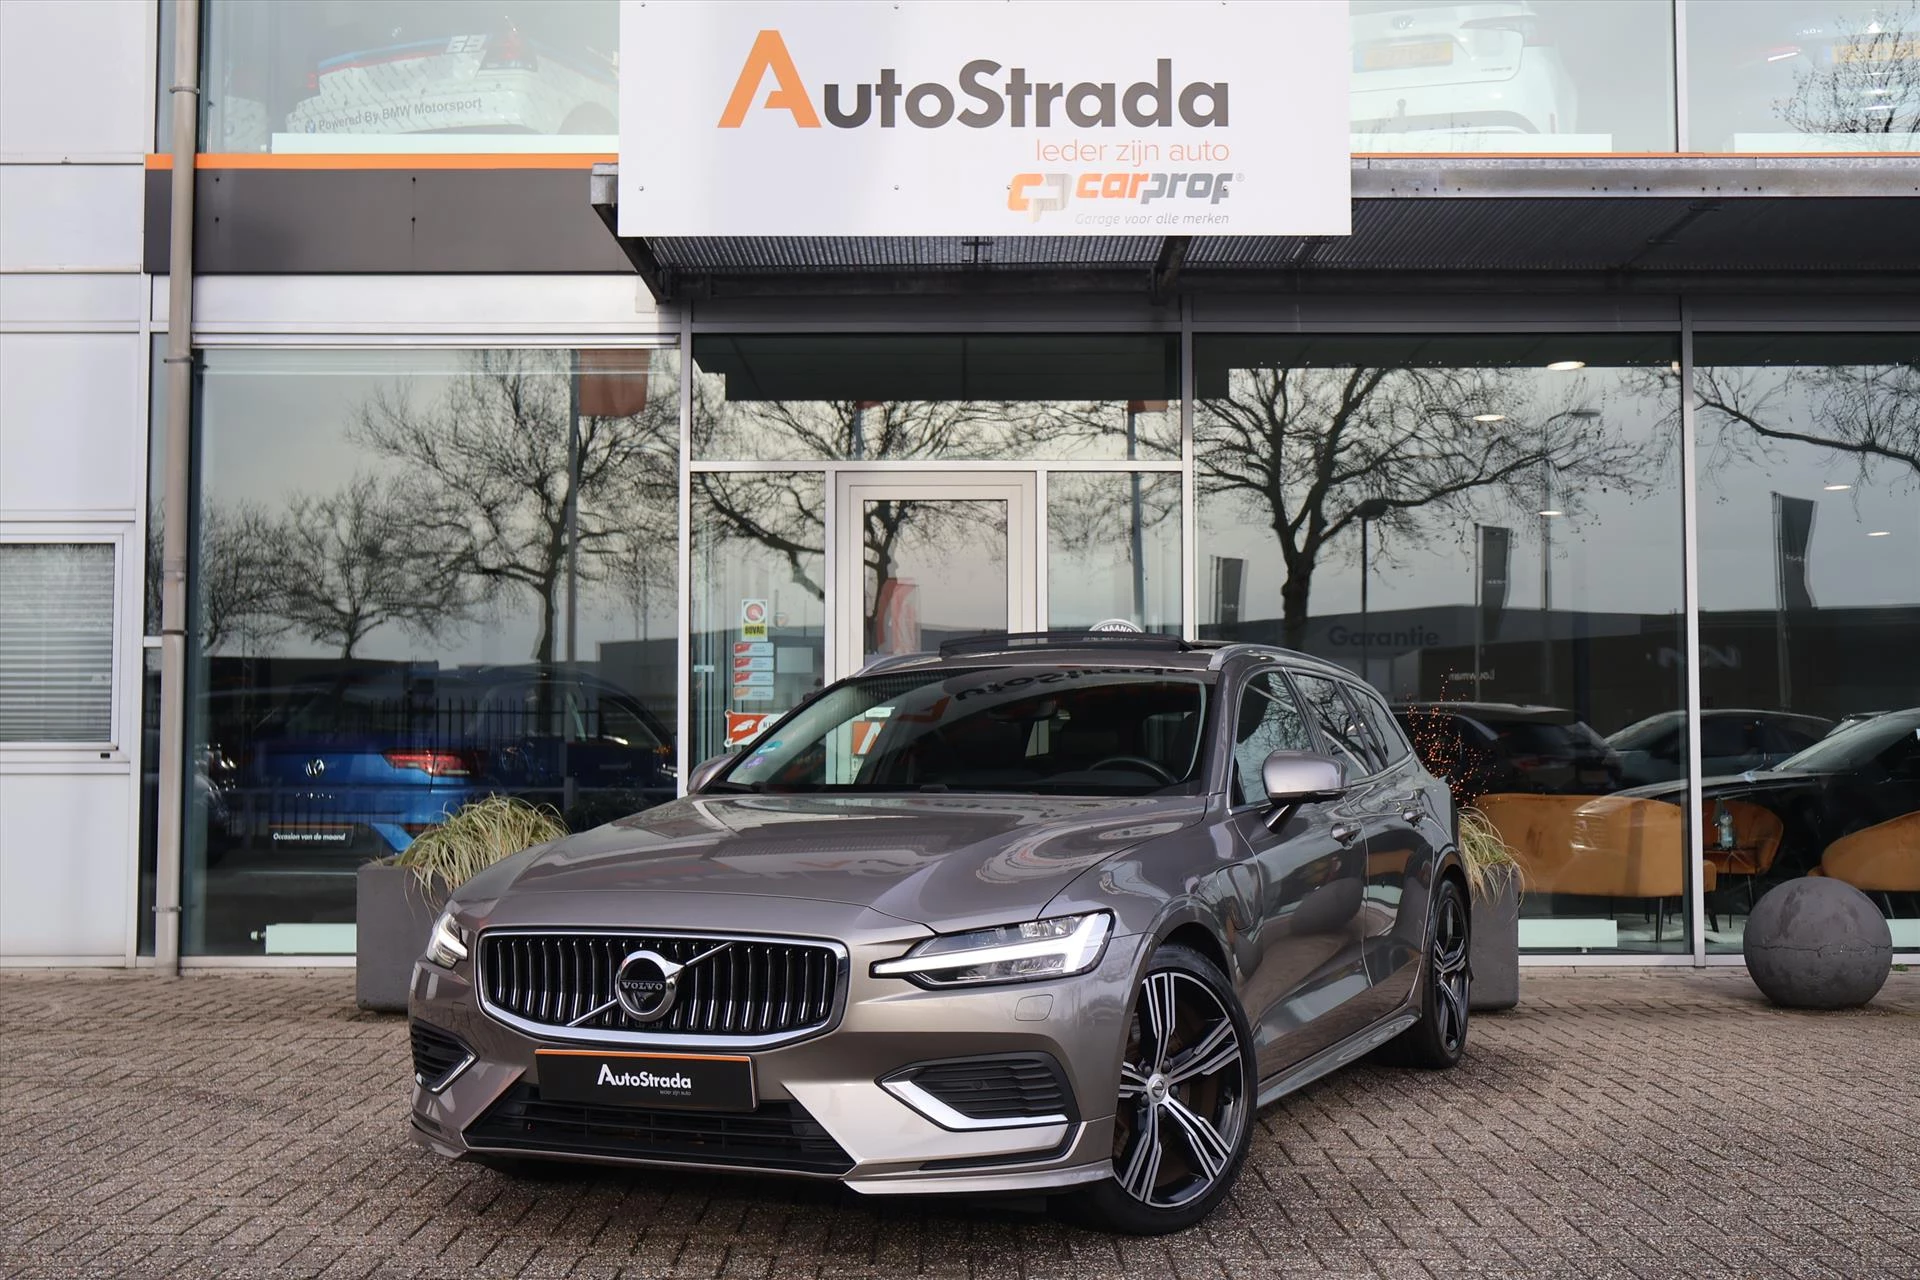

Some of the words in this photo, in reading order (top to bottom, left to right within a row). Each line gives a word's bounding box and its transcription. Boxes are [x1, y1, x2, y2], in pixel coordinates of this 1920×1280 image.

[716, 30, 1229, 129] AutoStrada
[318, 113, 361, 131] Powered
[364, 110, 379, 124] By
[382, 105, 411, 119] BMW
[414, 97, 483, 116] Motorsport
[1036, 139, 1108, 162] Ieder
[1115, 139, 1160, 167] zijn
[1169, 141, 1230, 162] auto
[1075, 172, 1234, 205] carprof
[1075, 213, 1121, 227] Garage
[1124, 215, 1153, 225] voor
[1155, 212, 1179, 225] alle
[1182, 212, 1230, 225] merken
[1328, 625, 1440, 647] Garantie
[273, 833, 300, 841] Occasion
[323, 833, 346, 841] maand
[621, 981, 663, 991] VOLVO
[597, 1063, 691, 1088] AutoStrada
